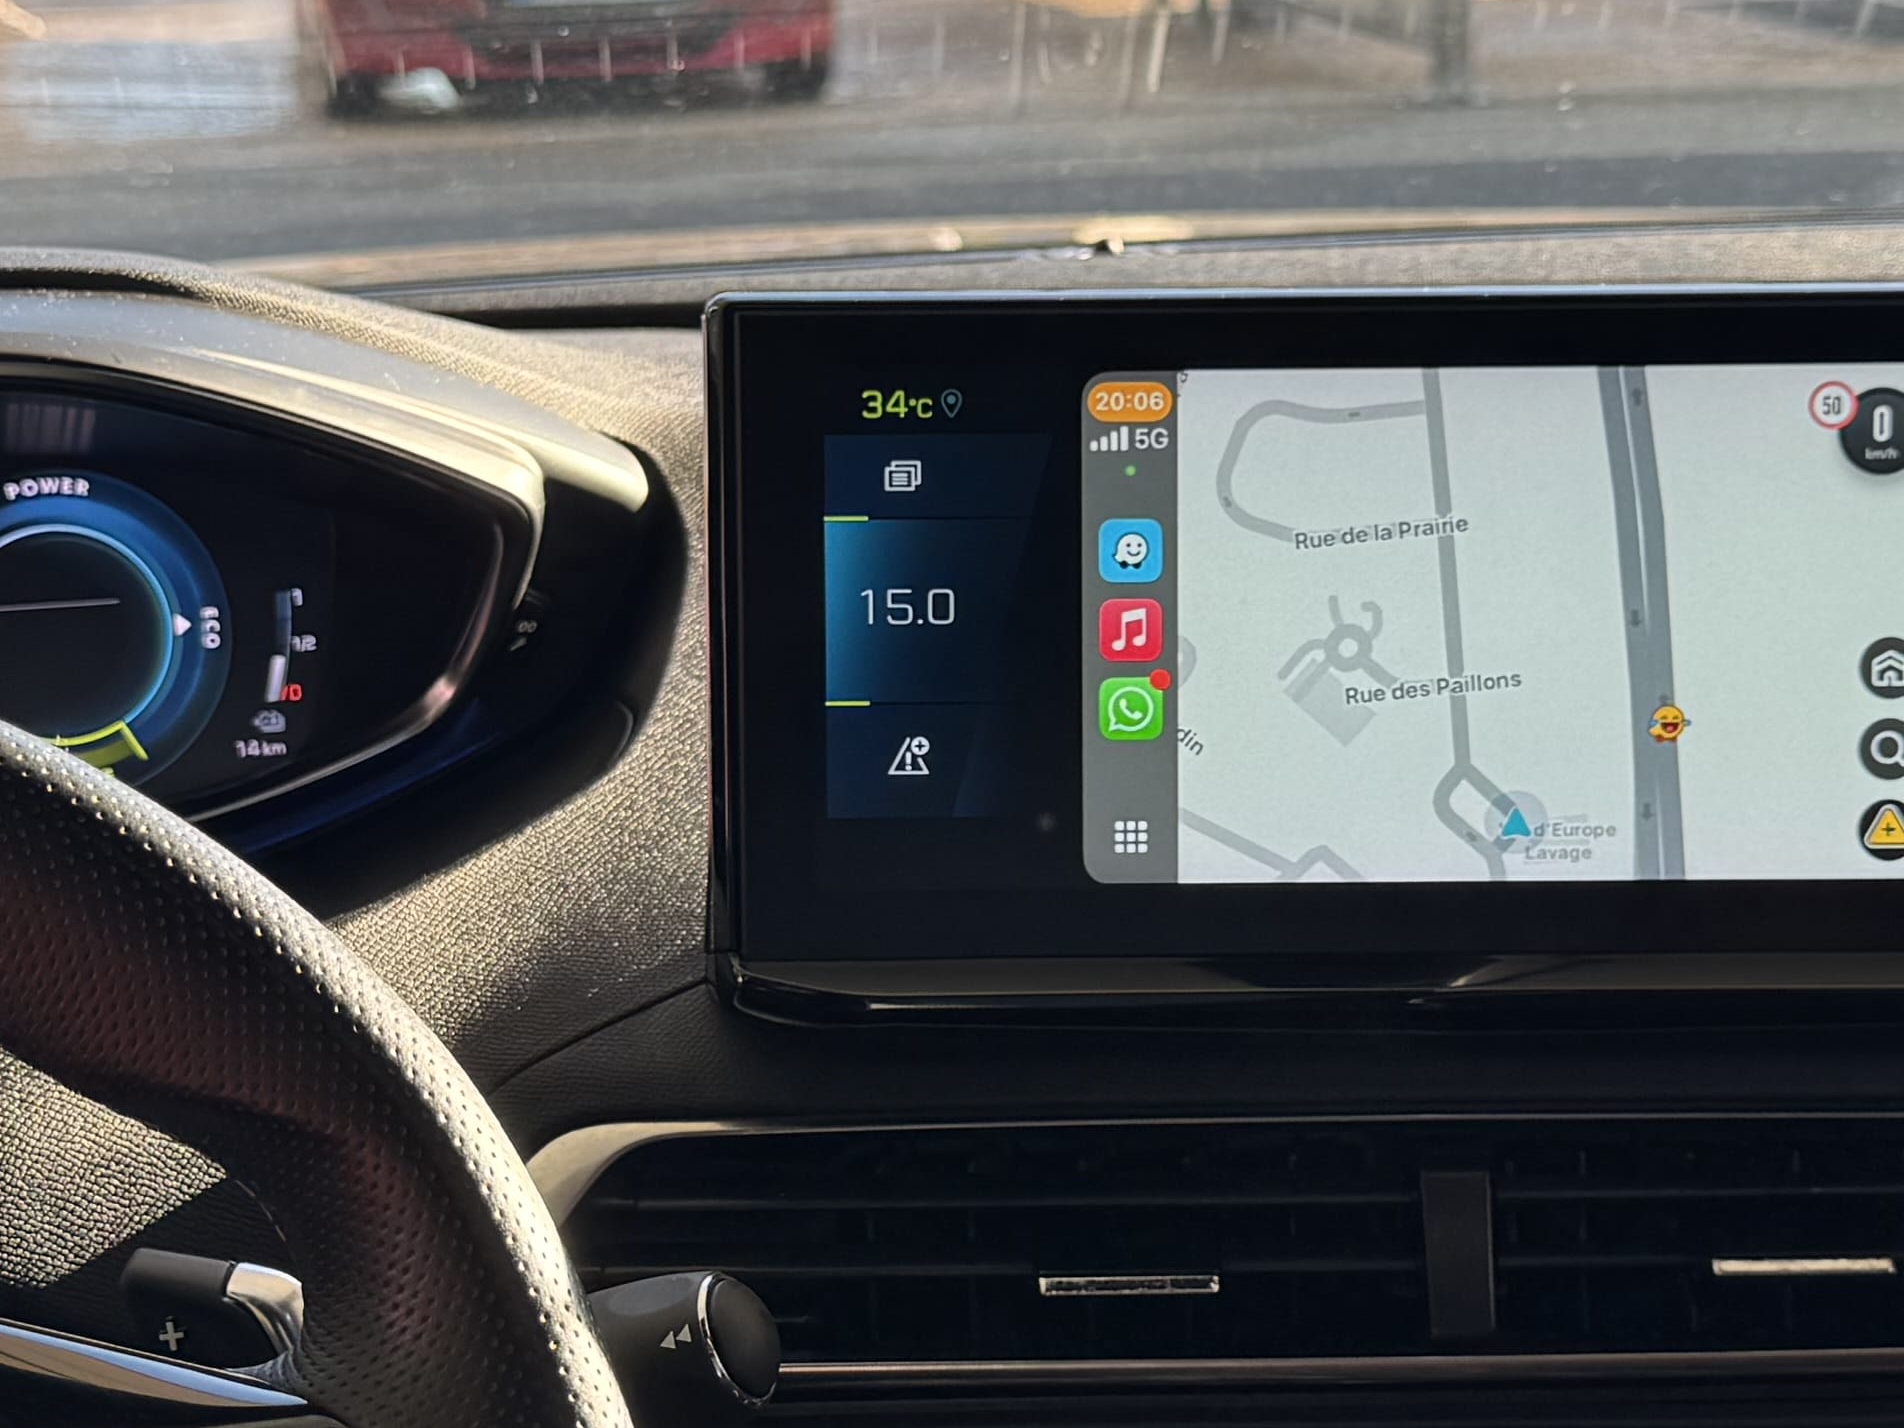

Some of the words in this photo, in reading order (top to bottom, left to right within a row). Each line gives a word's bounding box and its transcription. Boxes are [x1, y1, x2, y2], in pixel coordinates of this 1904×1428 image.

[862, 390, 933, 419] 34°C
[1095, 391, 1164, 411] 20:06
[1822, 395, 1841, 415] 50
[1872, 404, 1893, 442] 0
[1134, 428, 1169, 449] 5G
[3, 476, 90, 501] POWER
[1295, 532, 1335, 549] Rue
[1341, 526, 1368, 545] de
[1374, 524, 1392, 541] la
[1399, 517, 1469, 539] Prairie
[860, 588, 955, 625] 15.0
[199, 606, 221, 649] ECO
[1345, 687, 1385, 705] Rue
[1392, 682, 1430, 700] des
[1436, 673, 1522, 695] Paillons
[1534, 822, 1617, 839] d'Europe
[1525, 846, 1592, 862] Lavage
